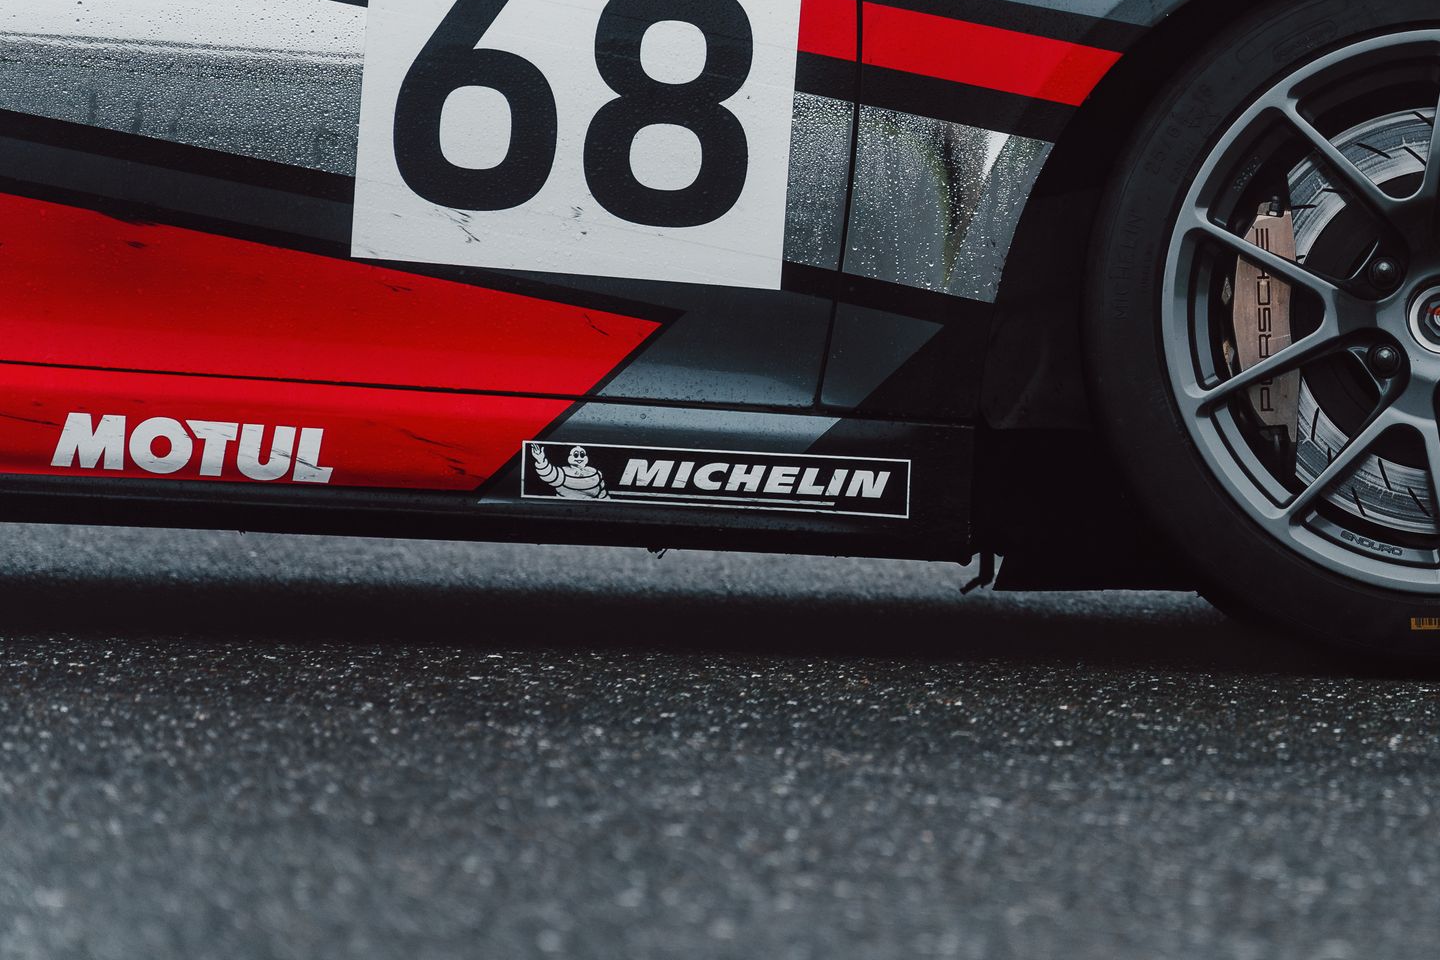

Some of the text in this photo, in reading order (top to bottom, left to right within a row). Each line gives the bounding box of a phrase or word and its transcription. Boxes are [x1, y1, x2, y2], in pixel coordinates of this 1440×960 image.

[51, 412, 335, 484] MOTUL
[617, 457, 891, 500] MICHELIN
[1339, 529, 1404, 557] ENDURO
